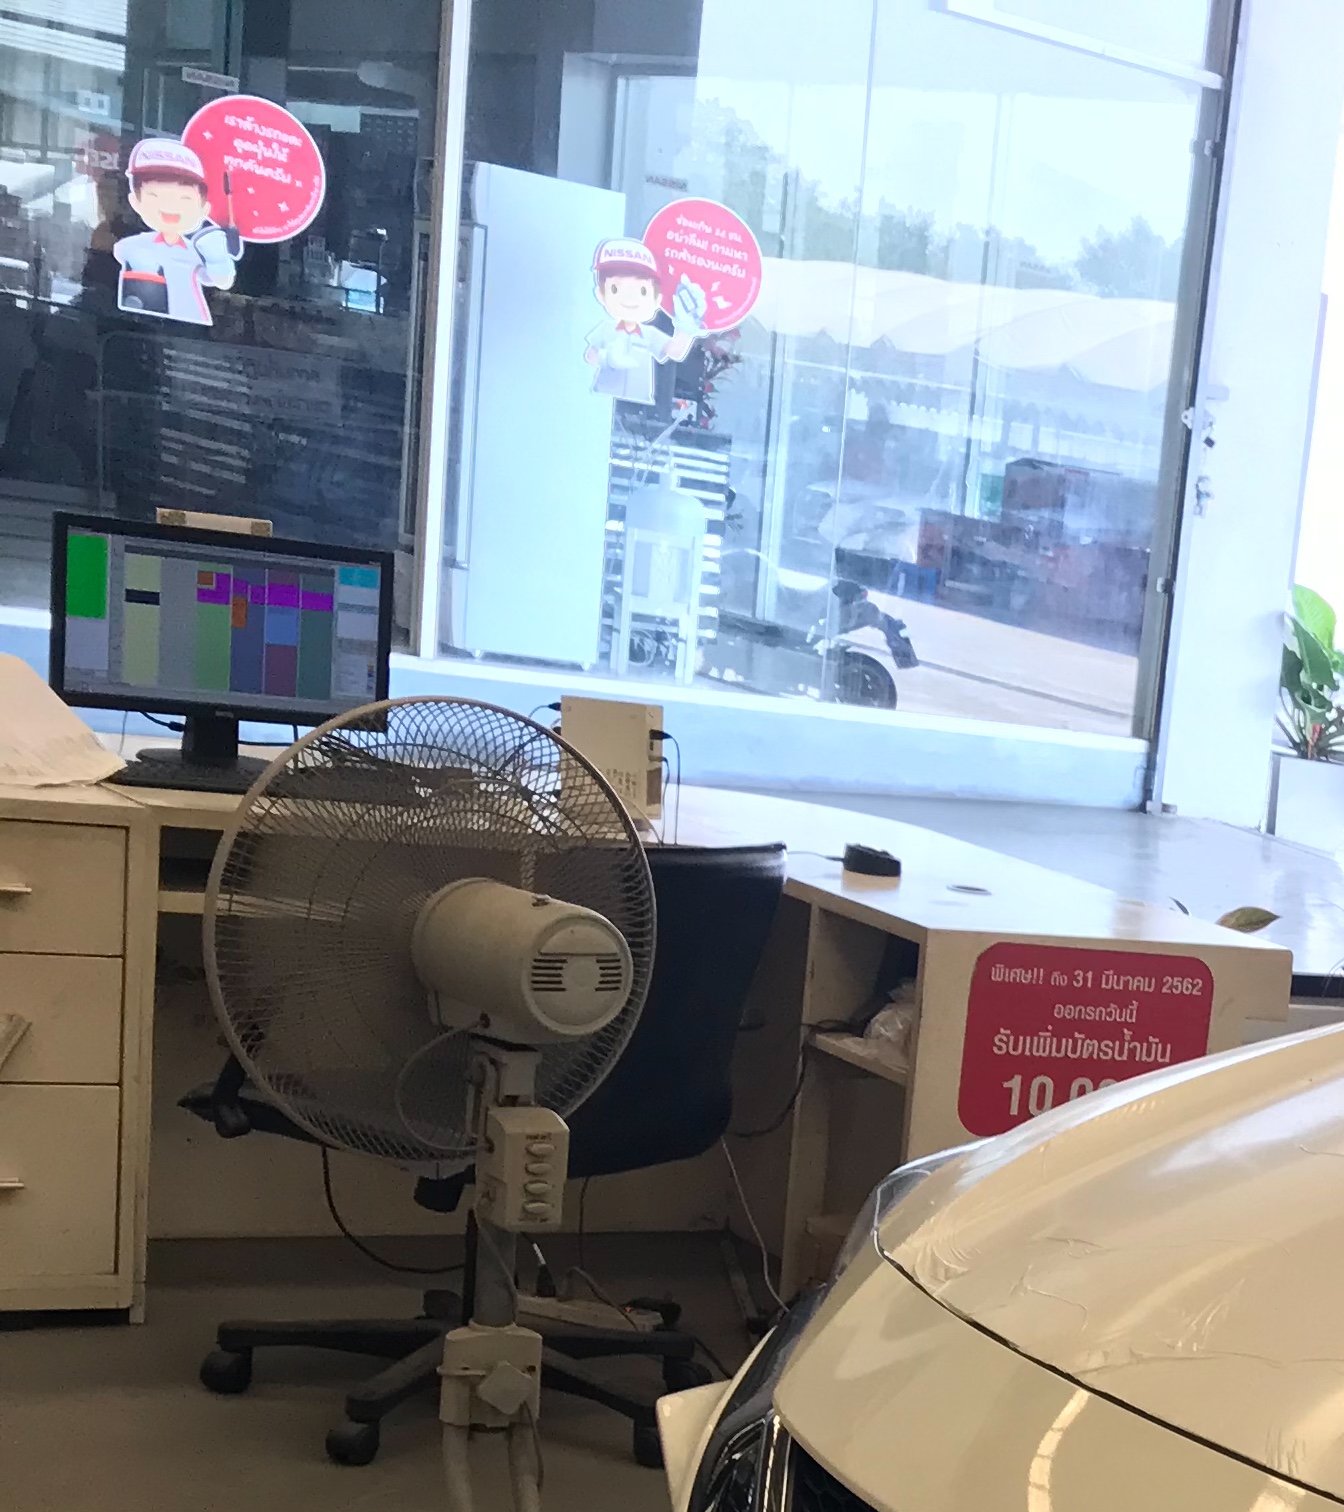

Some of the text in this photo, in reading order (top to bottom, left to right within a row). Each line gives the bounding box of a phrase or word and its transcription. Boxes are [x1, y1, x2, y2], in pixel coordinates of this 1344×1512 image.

[603, 247, 653, 267] NISSAN
[990, 963, 1203, 996] พิเศษ!! ถึง 31 มีนาคม 2562
[1053, 1000, 1139, 1024] ออกรถวันนี้
[992, 1024, 1172, 1064] รับเพิ่มบัตรน้ำมัน
